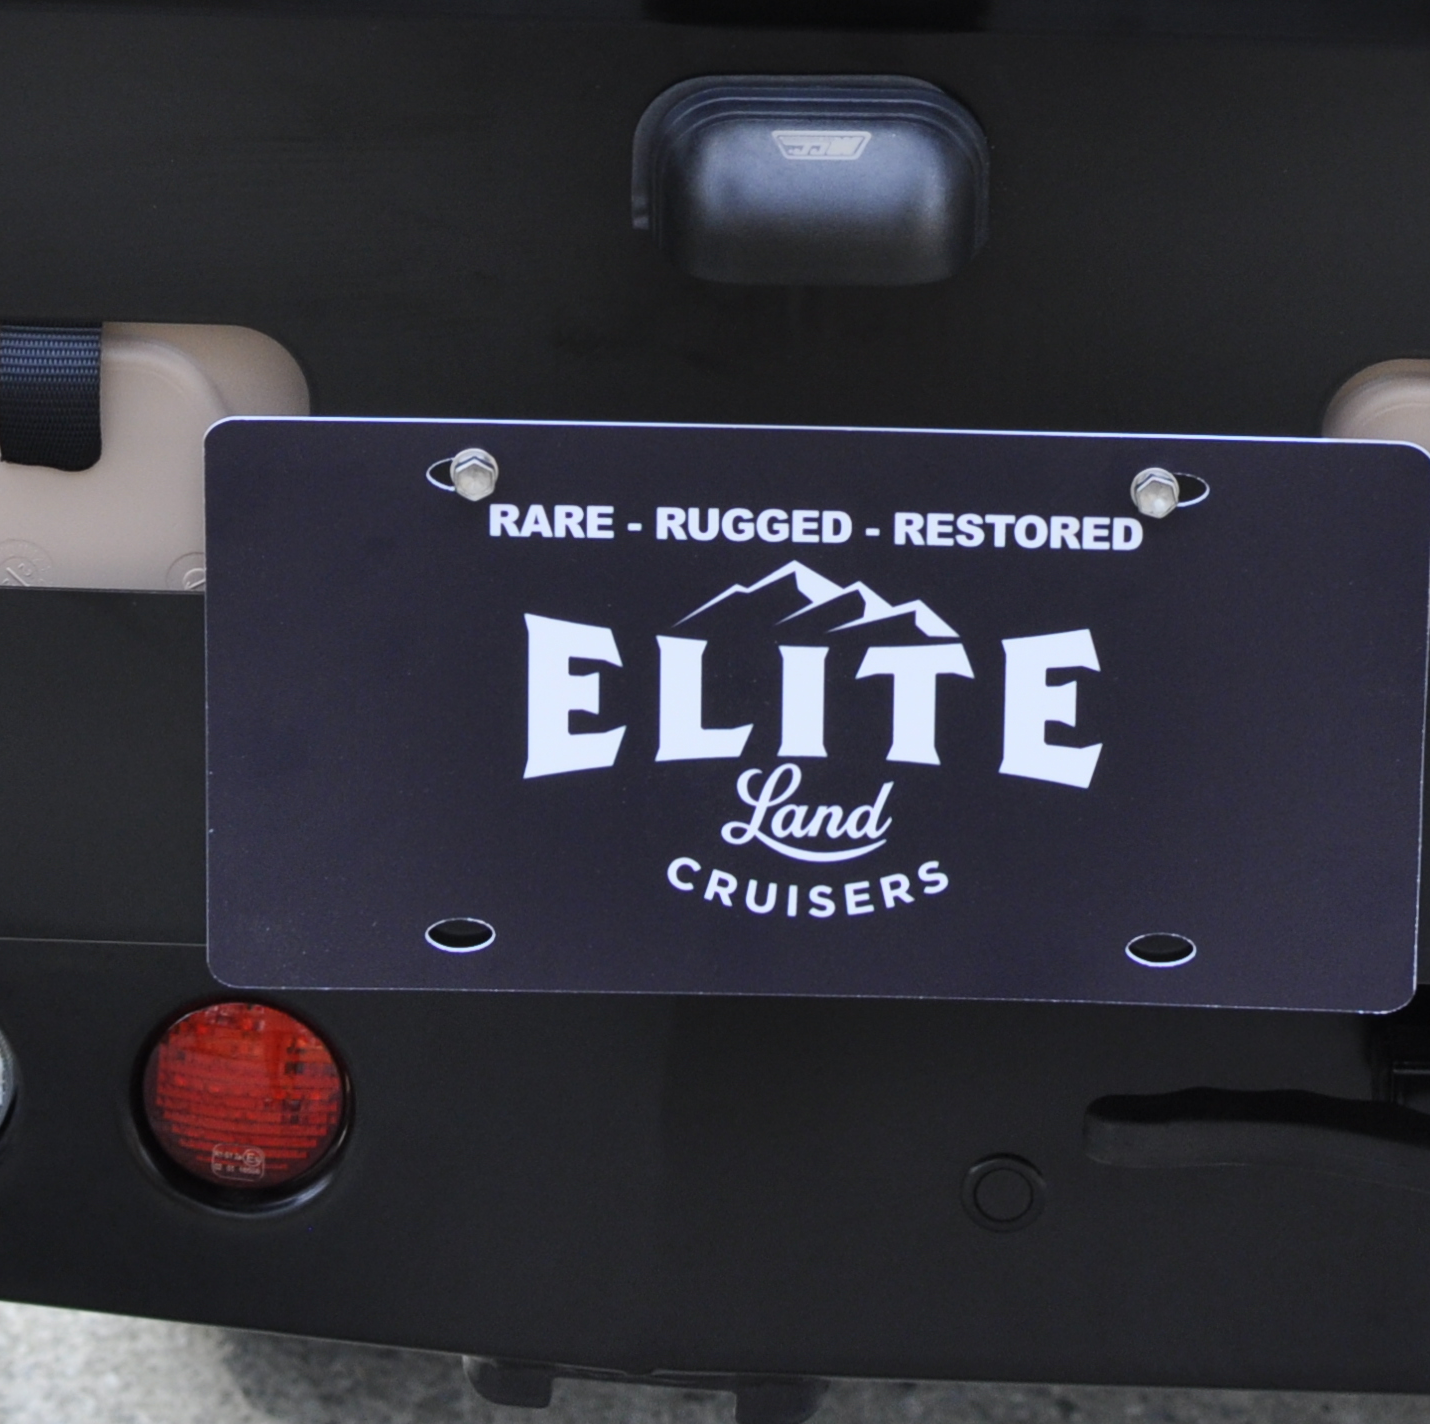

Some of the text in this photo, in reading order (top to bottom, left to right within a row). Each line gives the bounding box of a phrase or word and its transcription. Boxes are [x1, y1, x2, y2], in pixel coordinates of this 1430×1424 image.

[490, 503, 615, 539] RARE
[656, 506, 853, 544] RUGGED
[894, 511, 1144, 551] RESTORED
[523, 612, 1103, 789] ELITE
[720, 762, 894, 862] Land
[666, 856, 949, 918] CRUISERS
